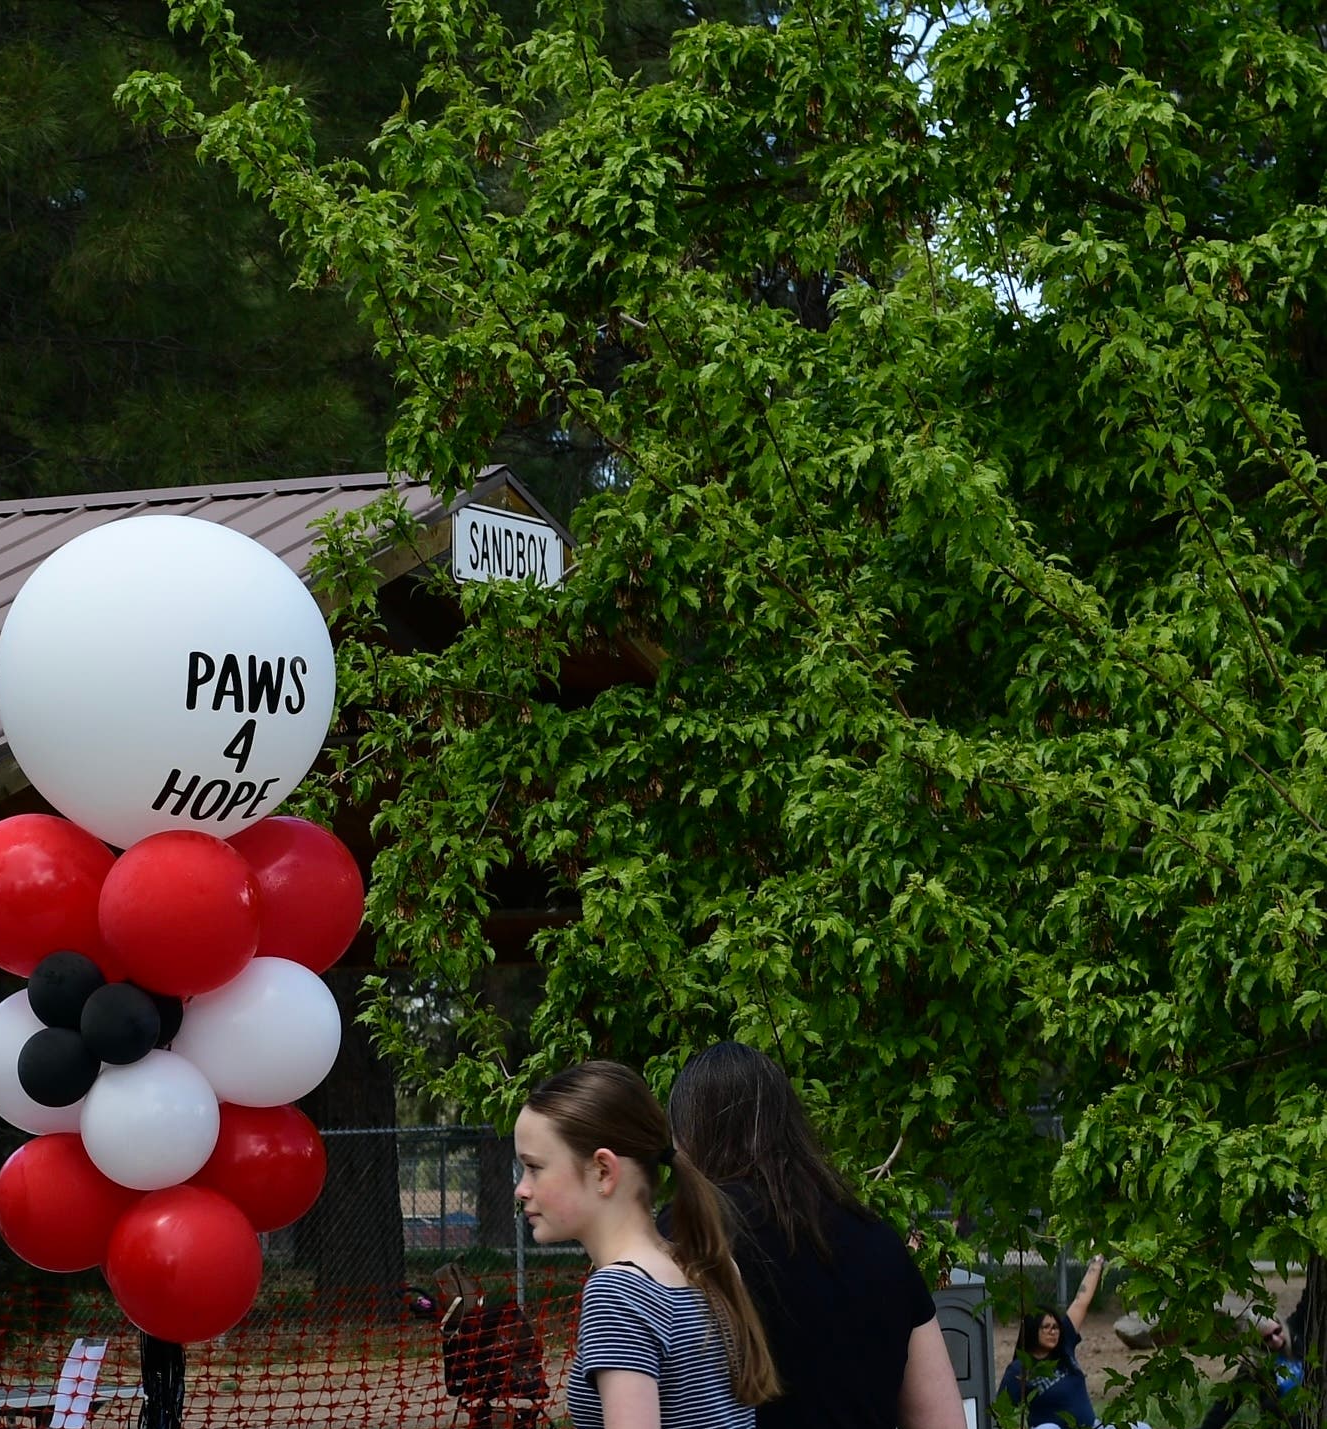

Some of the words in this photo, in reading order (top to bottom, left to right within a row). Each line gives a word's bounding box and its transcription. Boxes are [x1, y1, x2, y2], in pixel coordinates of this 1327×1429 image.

[469, 521, 548, 585] SANDBOX
[185, 651, 308, 715] PAWS
[222, 719, 257, 774] 4
[151, 768, 280, 823] HOPE
